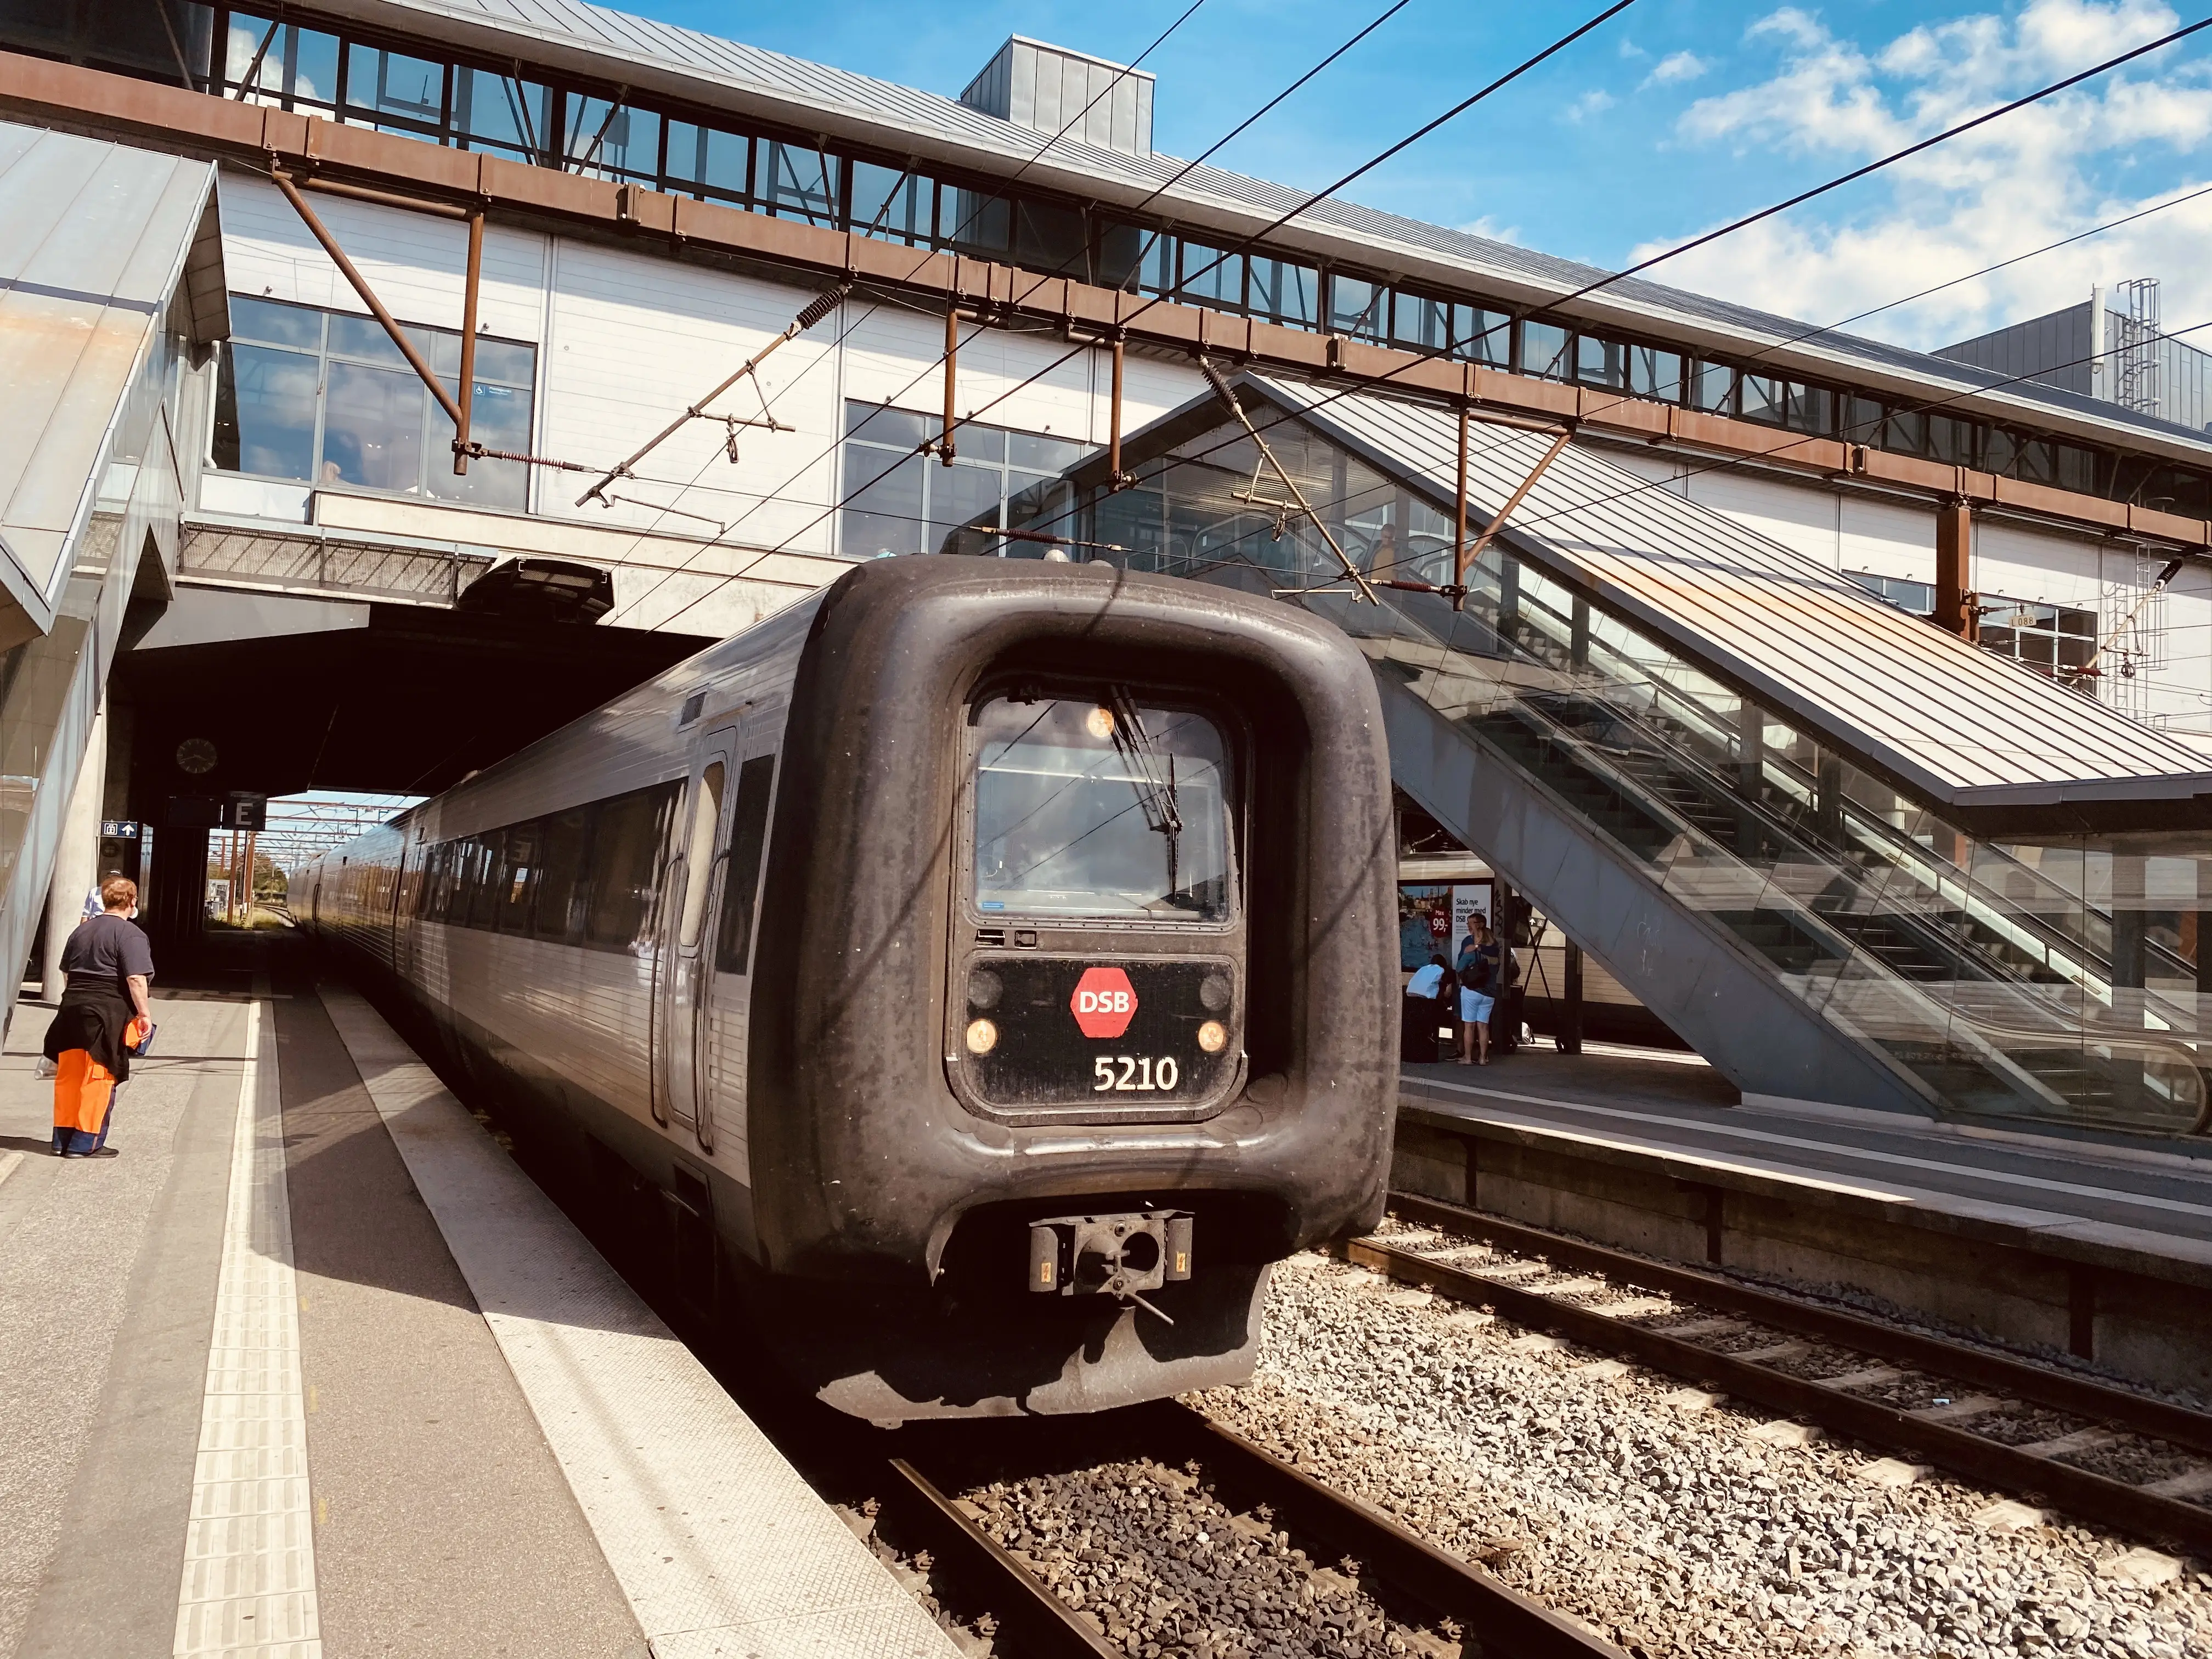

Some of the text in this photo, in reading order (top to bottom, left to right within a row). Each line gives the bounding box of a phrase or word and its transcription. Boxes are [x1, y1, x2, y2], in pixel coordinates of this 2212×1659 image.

[2018, 617, 2033, 626] 088
[235, 802, 253, 826] E
[1080, 991, 1130, 1013] DSB
[1094, 1056, 1178, 1091] 5210
